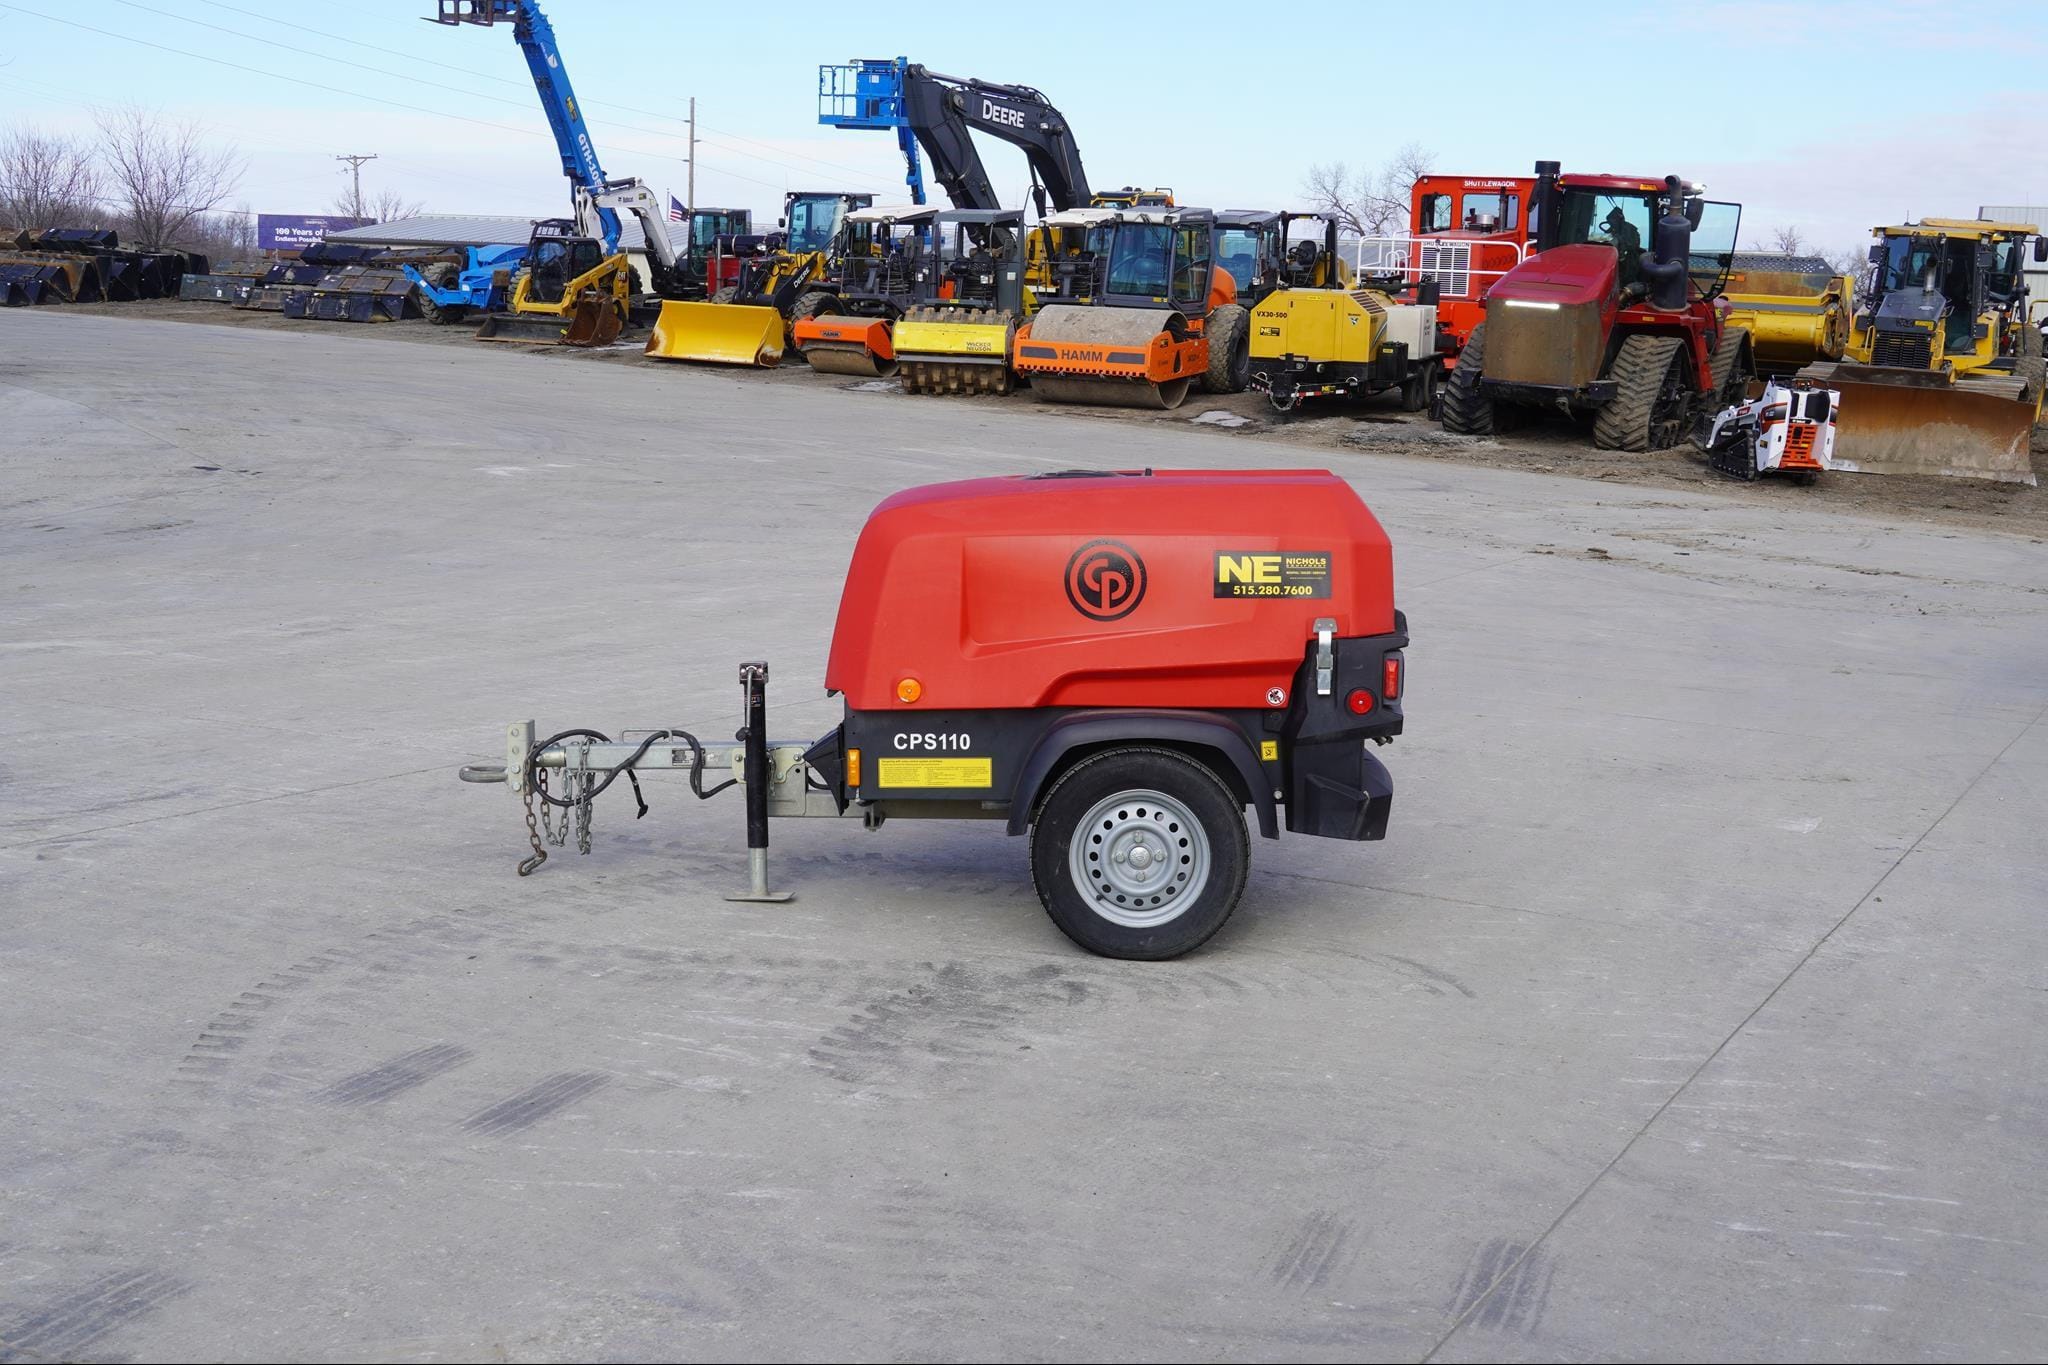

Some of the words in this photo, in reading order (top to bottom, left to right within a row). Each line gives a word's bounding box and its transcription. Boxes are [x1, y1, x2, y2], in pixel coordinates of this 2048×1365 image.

[982, 99, 1025, 129] DEERE
[1464, 180, 1516, 188] SHUTTLEWAGON
[292, 228, 313, 236] Years
[315, 228, 323, 236] of
[1256, 310, 1288, 319] VX30-500
[1061, 349, 1103, 363] HAMM
[1286, 557, 1326, 565] NICHOLS
[1219, 556, 1282, 583] NE
[1233, 586, 1313, 595] 515.280.7600
[893, 733, 971, 750] CPS110
